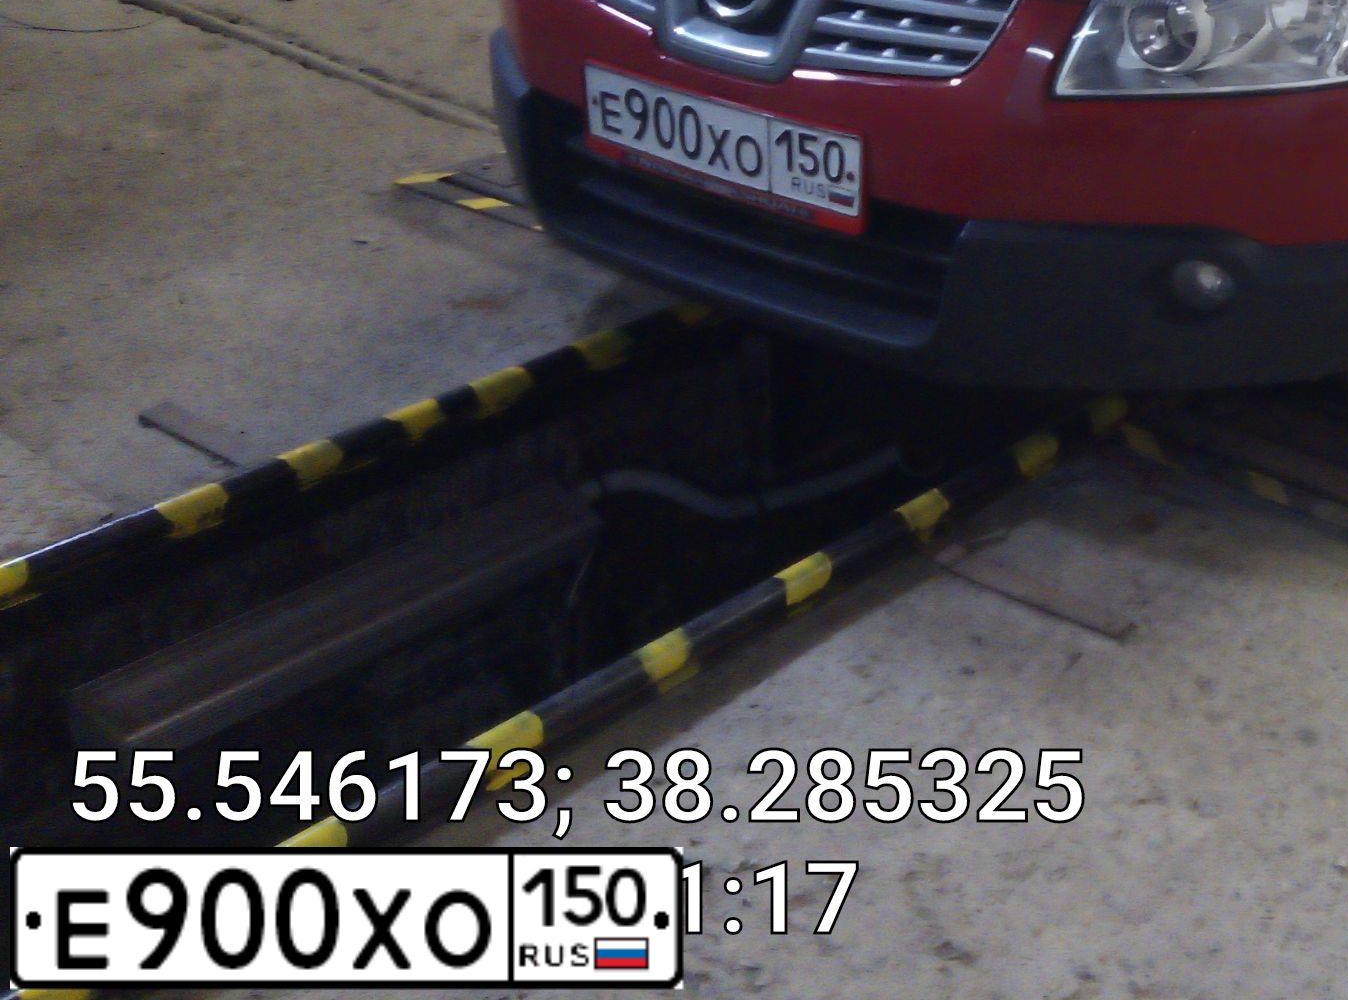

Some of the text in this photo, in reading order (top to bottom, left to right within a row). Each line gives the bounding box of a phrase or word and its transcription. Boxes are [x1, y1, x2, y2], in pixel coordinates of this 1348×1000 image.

[600, 88, 846, 184] E900XO 150
[791, 177, 827, 199] RUS
